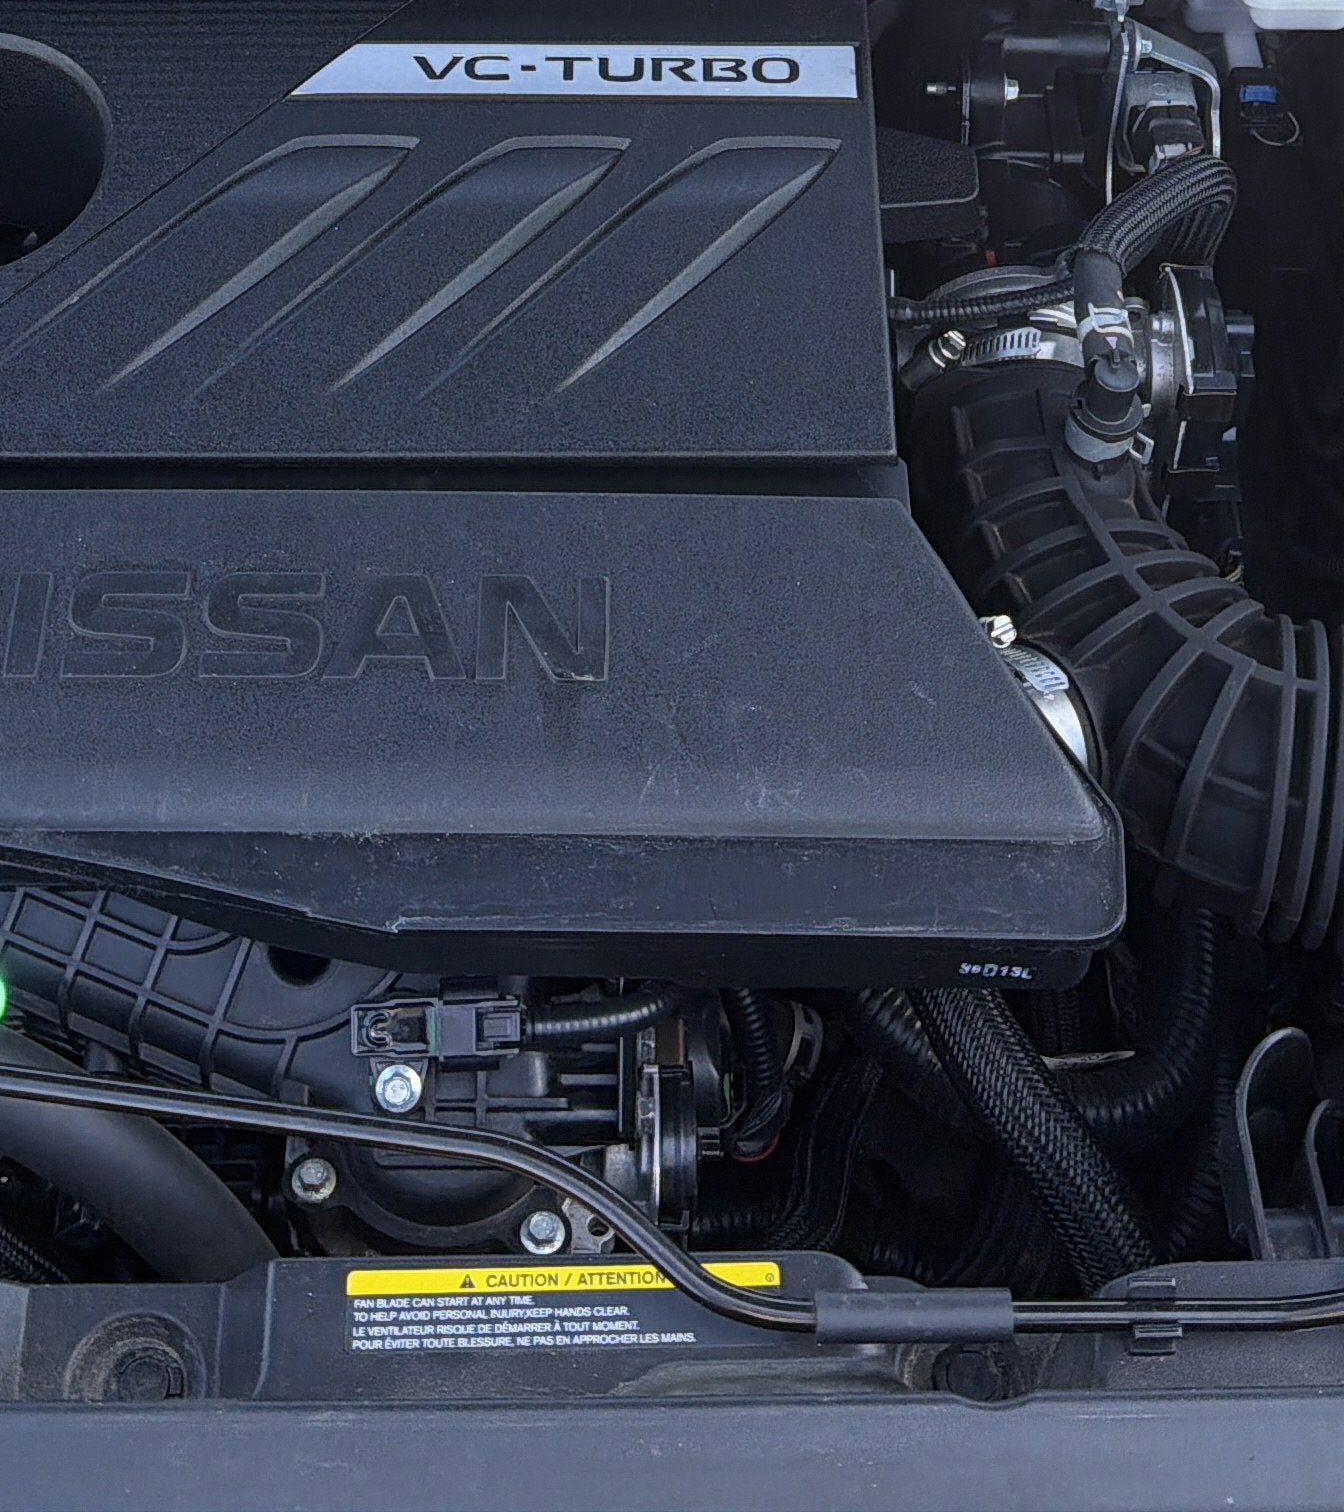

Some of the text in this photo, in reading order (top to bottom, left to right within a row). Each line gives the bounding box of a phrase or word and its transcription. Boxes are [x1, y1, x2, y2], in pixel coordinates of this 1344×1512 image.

[413, 55, 800, 84] VC-TURBO
[485, 1271, 667, 1288] CAUTION / ATTENTION
[354, 1295, 535, 1308] FAN BLADE CAN START AT ANY TIME.
[353, 1312, 368, 1322] TO
[370, 1311, 397, 1321] HELP
[399, 1310, 430, 1320] AVOID
[432, 1309, 489, 1320] PERSONAL
[555, 1308, 591, 1317] HANDS
[594, 1306, 630, 1316] CLEAR.
[353, 1327, 366, 1337] LE
[368, 1325, 434, 1336] VENTILATEUR
[436, 1324, 477, 1335] RISQUE
[479, 1324, 493, 1334] DE
[494, 1321, 551, 1333] DÉMARRER
[563, 1322, 591, 1332] TOUT
[592, 1321, 640, 1331] MOMENT.
[352, 1340, 383, 1350] POUR
[385, 1337, 420, 1349] ÉVITER
[421, 1338, 456, 1348] TOUTE
[517, 1337, 531, 1347] NE
[533, 1336, 554, 1346] PAS
[557, 1335, 571, 1345] EN
[572, 1334, 638, 1345] APPROCHER
[639, 1334, 659, 1344] LES
[660, 1332, 697, 1343] MAINS.
